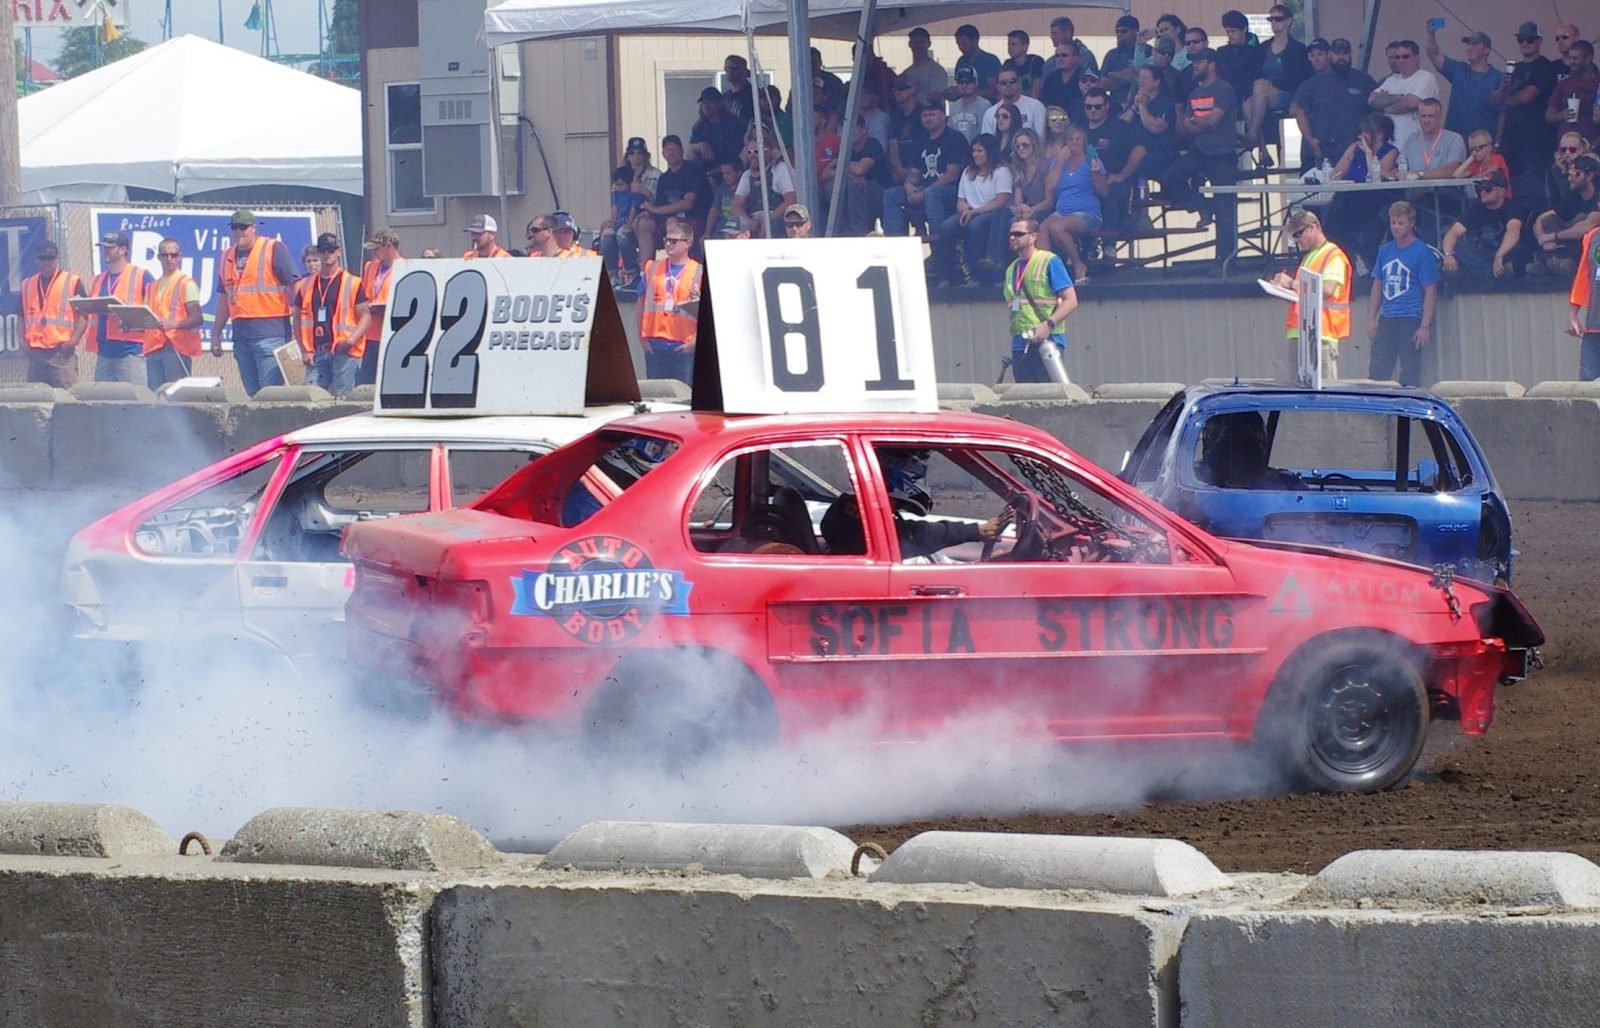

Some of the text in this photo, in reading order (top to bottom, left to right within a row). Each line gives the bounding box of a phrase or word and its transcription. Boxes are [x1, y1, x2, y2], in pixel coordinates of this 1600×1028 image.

[492, 294, 590, 324] BODE'S
[380, 269, 488, 409] 22
[488, 330, 585, 351] PRECAST
[761, 265, 916, 393] 81
[560, 538, 643, 570] AUTO
[534, 571, 673, 610] CHARLIE'S
[1327, 578, 1421, 603] AXIOM
[563, 607, 643, 643] BODY
[809, 598, 1235, 656] SOFIA STRONG
